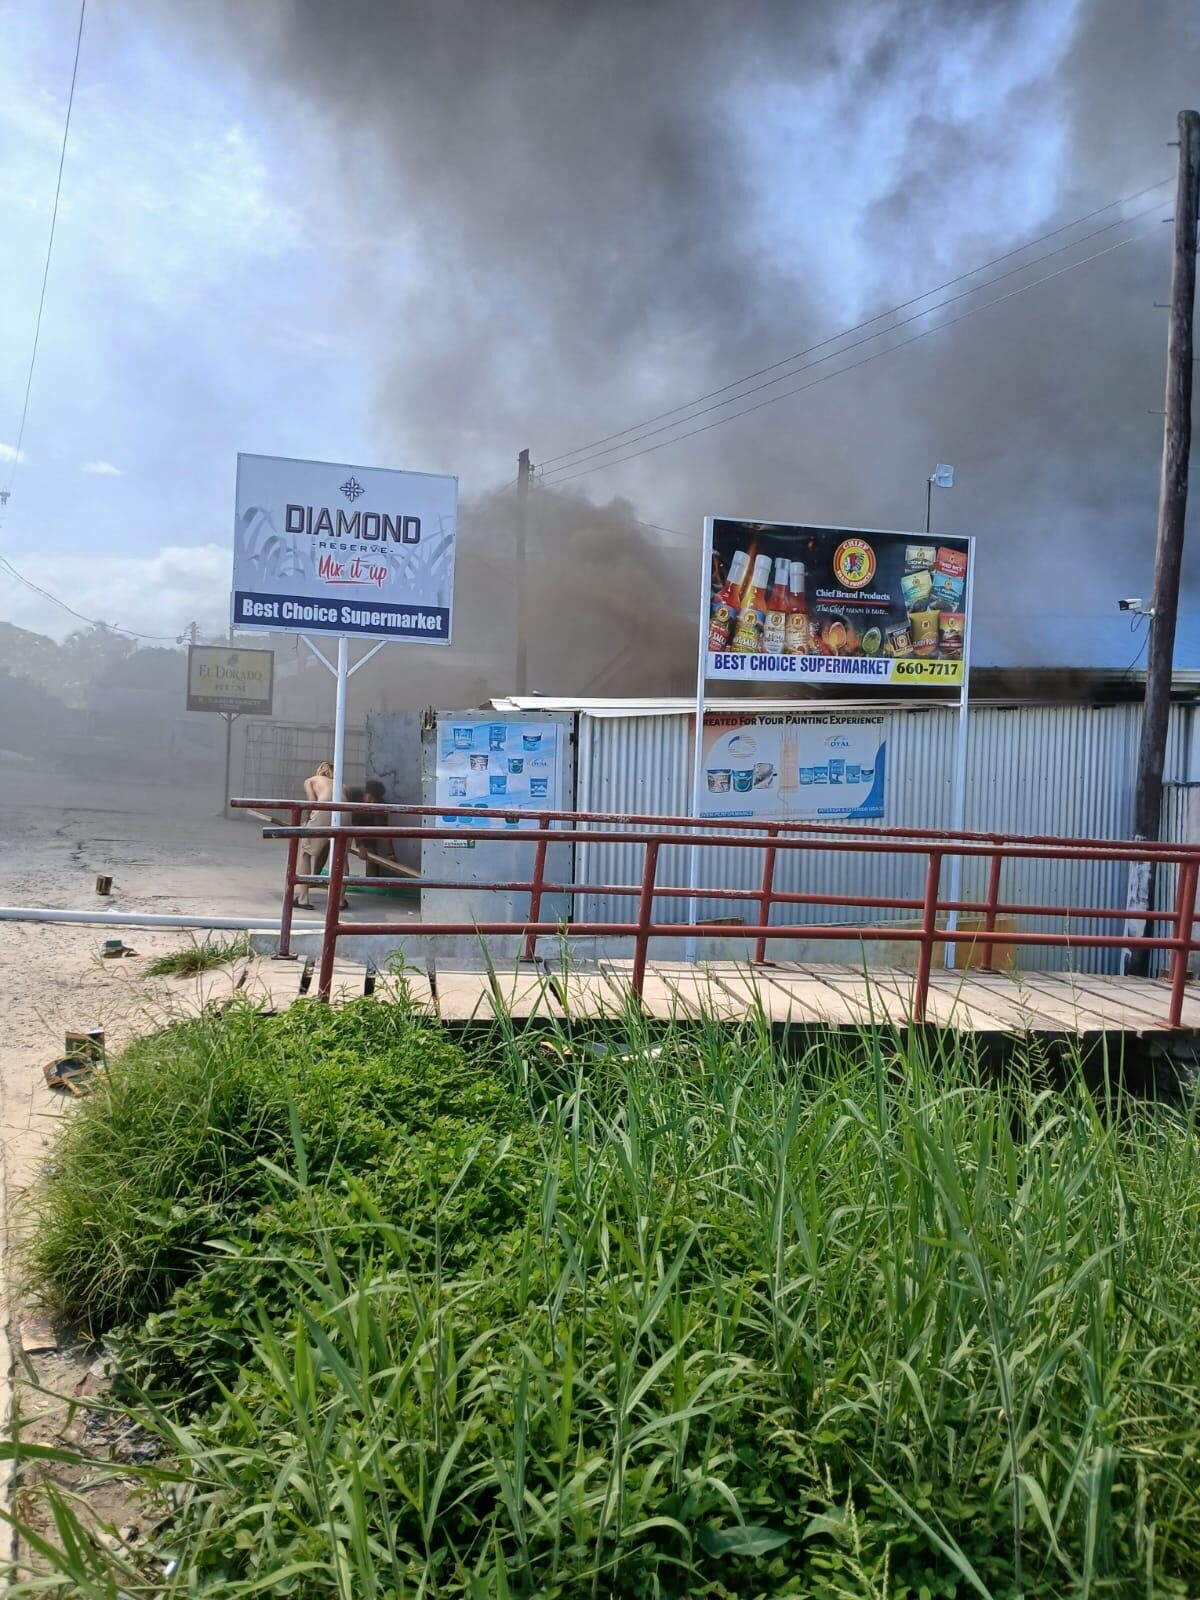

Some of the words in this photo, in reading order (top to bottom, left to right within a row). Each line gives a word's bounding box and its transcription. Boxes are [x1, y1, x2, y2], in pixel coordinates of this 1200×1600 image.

[285, 503, 421, 545] DIAMOND
[842, 540, 869, 550] CHIEF
[318, 554, 344, 580] Mix
[350, 557, 369, 579] it
[369, 563, 388, 588] up
[816, 589, 835, 598] Chief
[836, 590, 858, 599] Brand
[859, 591, 890, 600] Products
[242, 598, 279, 618] Best
[282, 601, 338, 623] Choice
[341, 606, 442, 631] Supermarket
[816, 603, 828, 612] The
[714, 653, 747, 671] BEST
[750, 655, 796, 673] CHOICE
[800, 657, 890, 675] SUPERMARKET
[895, 661, 958, 676] 660-7717
[703, 718, 738, 727] REATED
[785, 715, 828, 725] PAINTING
[829, 716, 884, 725] EXPERIENCE!
